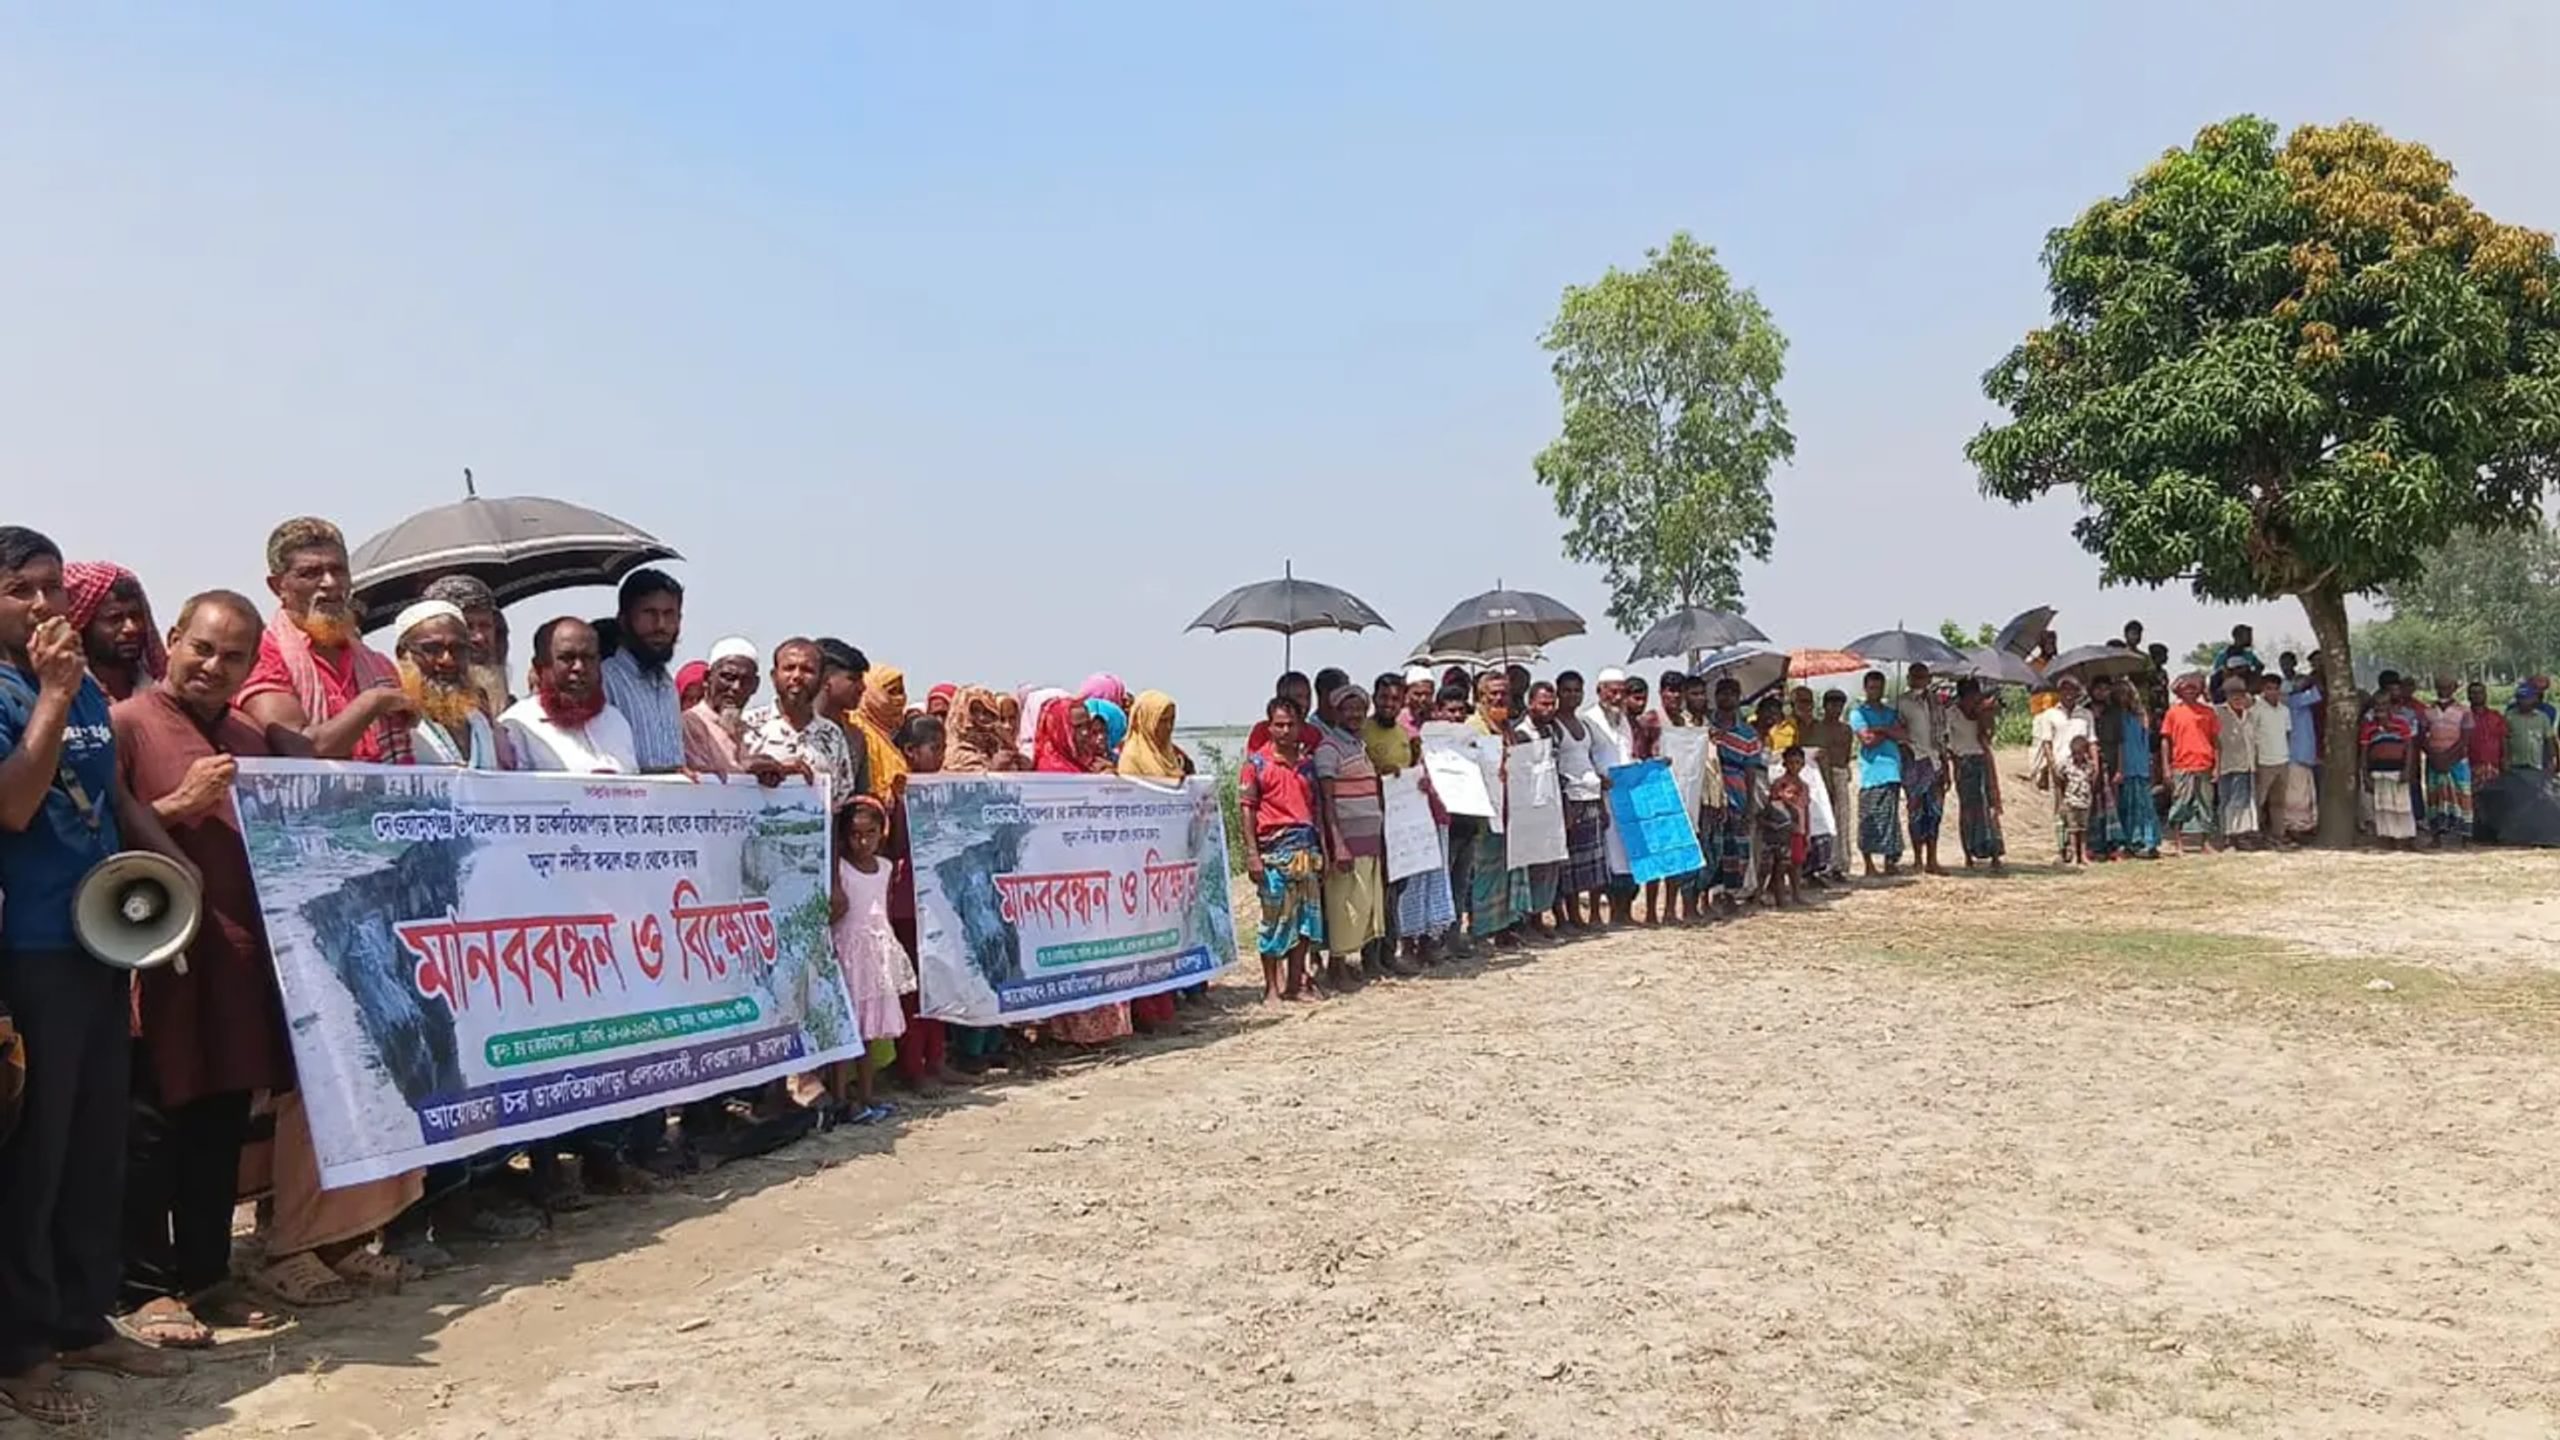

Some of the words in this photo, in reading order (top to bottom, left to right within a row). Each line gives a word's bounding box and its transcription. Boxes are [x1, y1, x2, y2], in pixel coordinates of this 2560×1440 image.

[994, 870, 1113, 929] মানববন্ধন
[1119, 870, 1138, 915] ও
[400, 910, 627, 1011] মানববন্ধন
[631, 911, 664, 981] ও
[670, 878, 778, 983] বিক্ষোভ
[501, 1089, 530, 1115] চর
